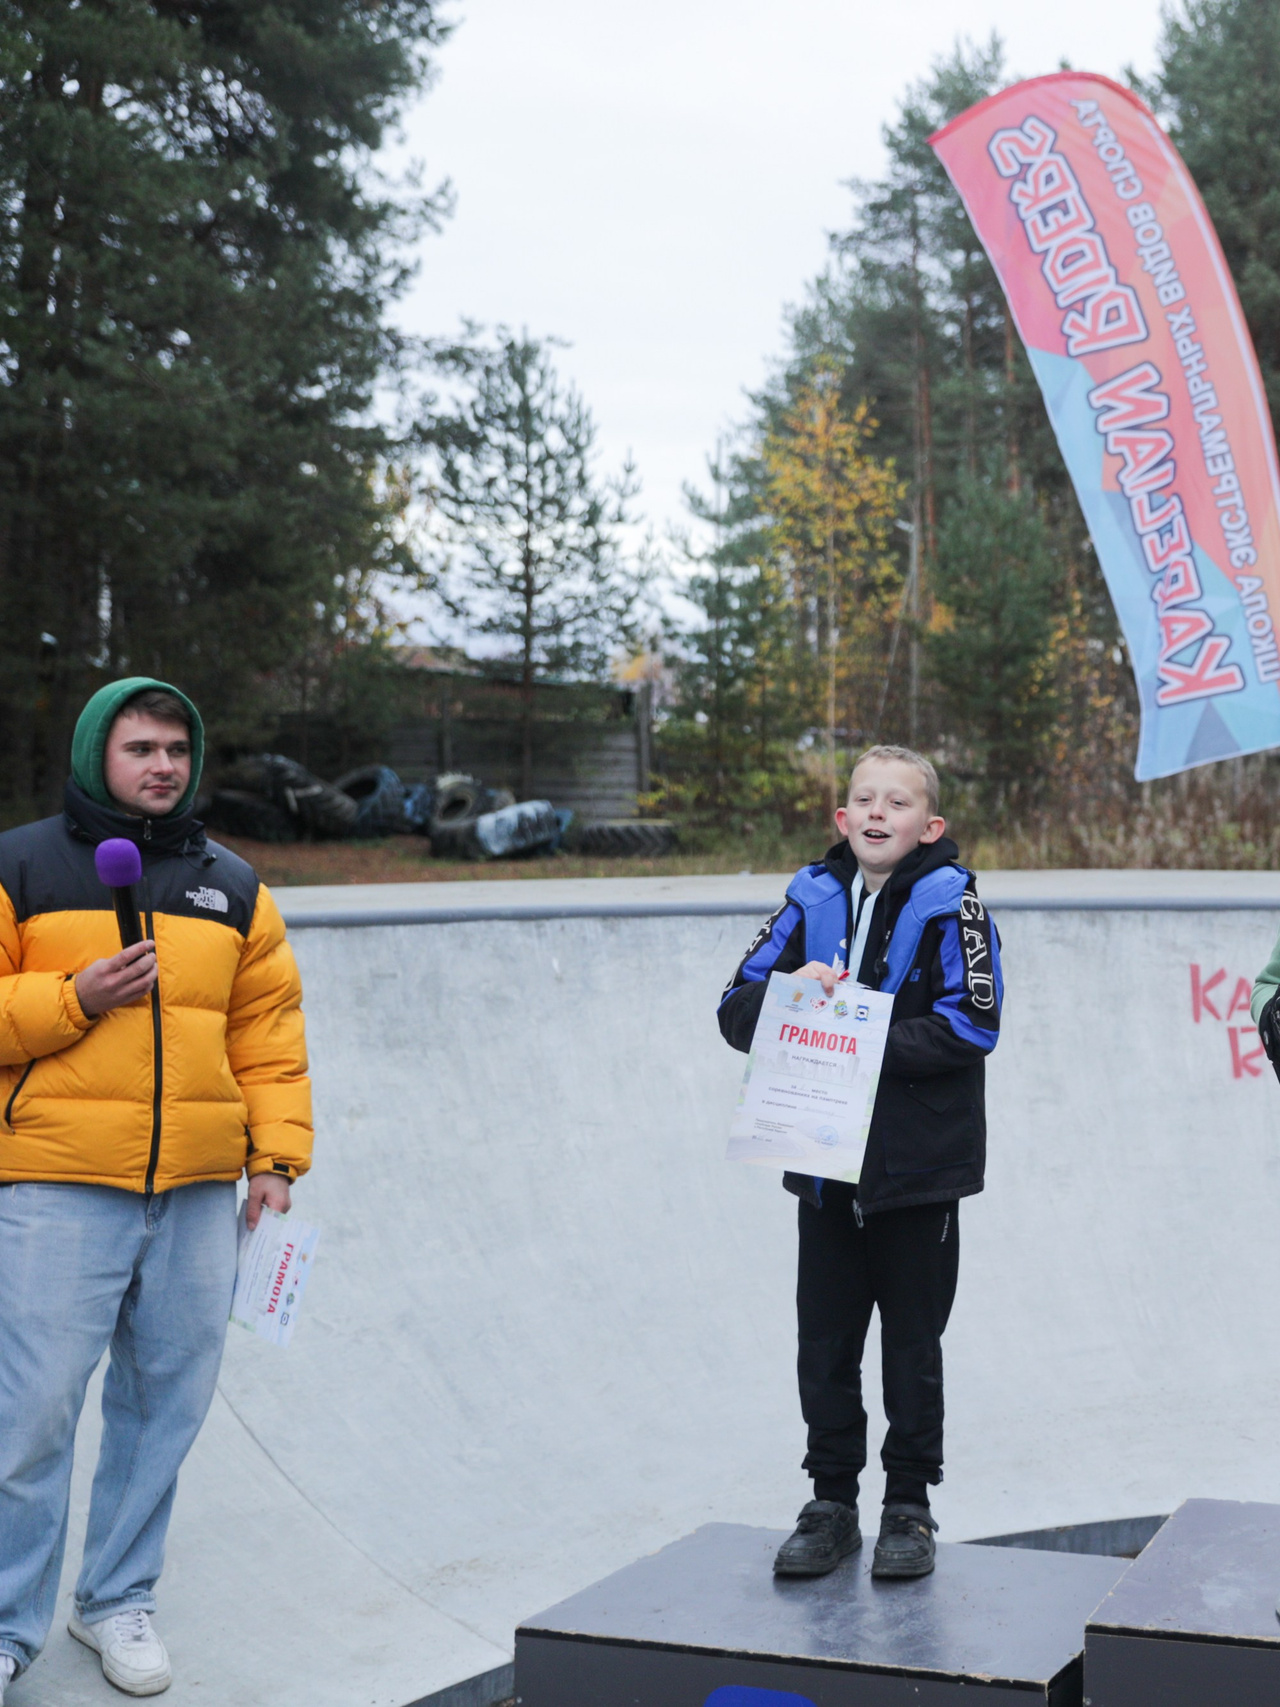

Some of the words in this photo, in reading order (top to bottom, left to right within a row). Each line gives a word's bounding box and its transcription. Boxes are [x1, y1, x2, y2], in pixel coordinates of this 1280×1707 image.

[778, 1023, 857, 1055] ГРАМОТА
[791, 1055, 838, 1068] НАГРАЖДАЕТСЯ
[267, 1242, 295, 1314] ГРАМОТА
